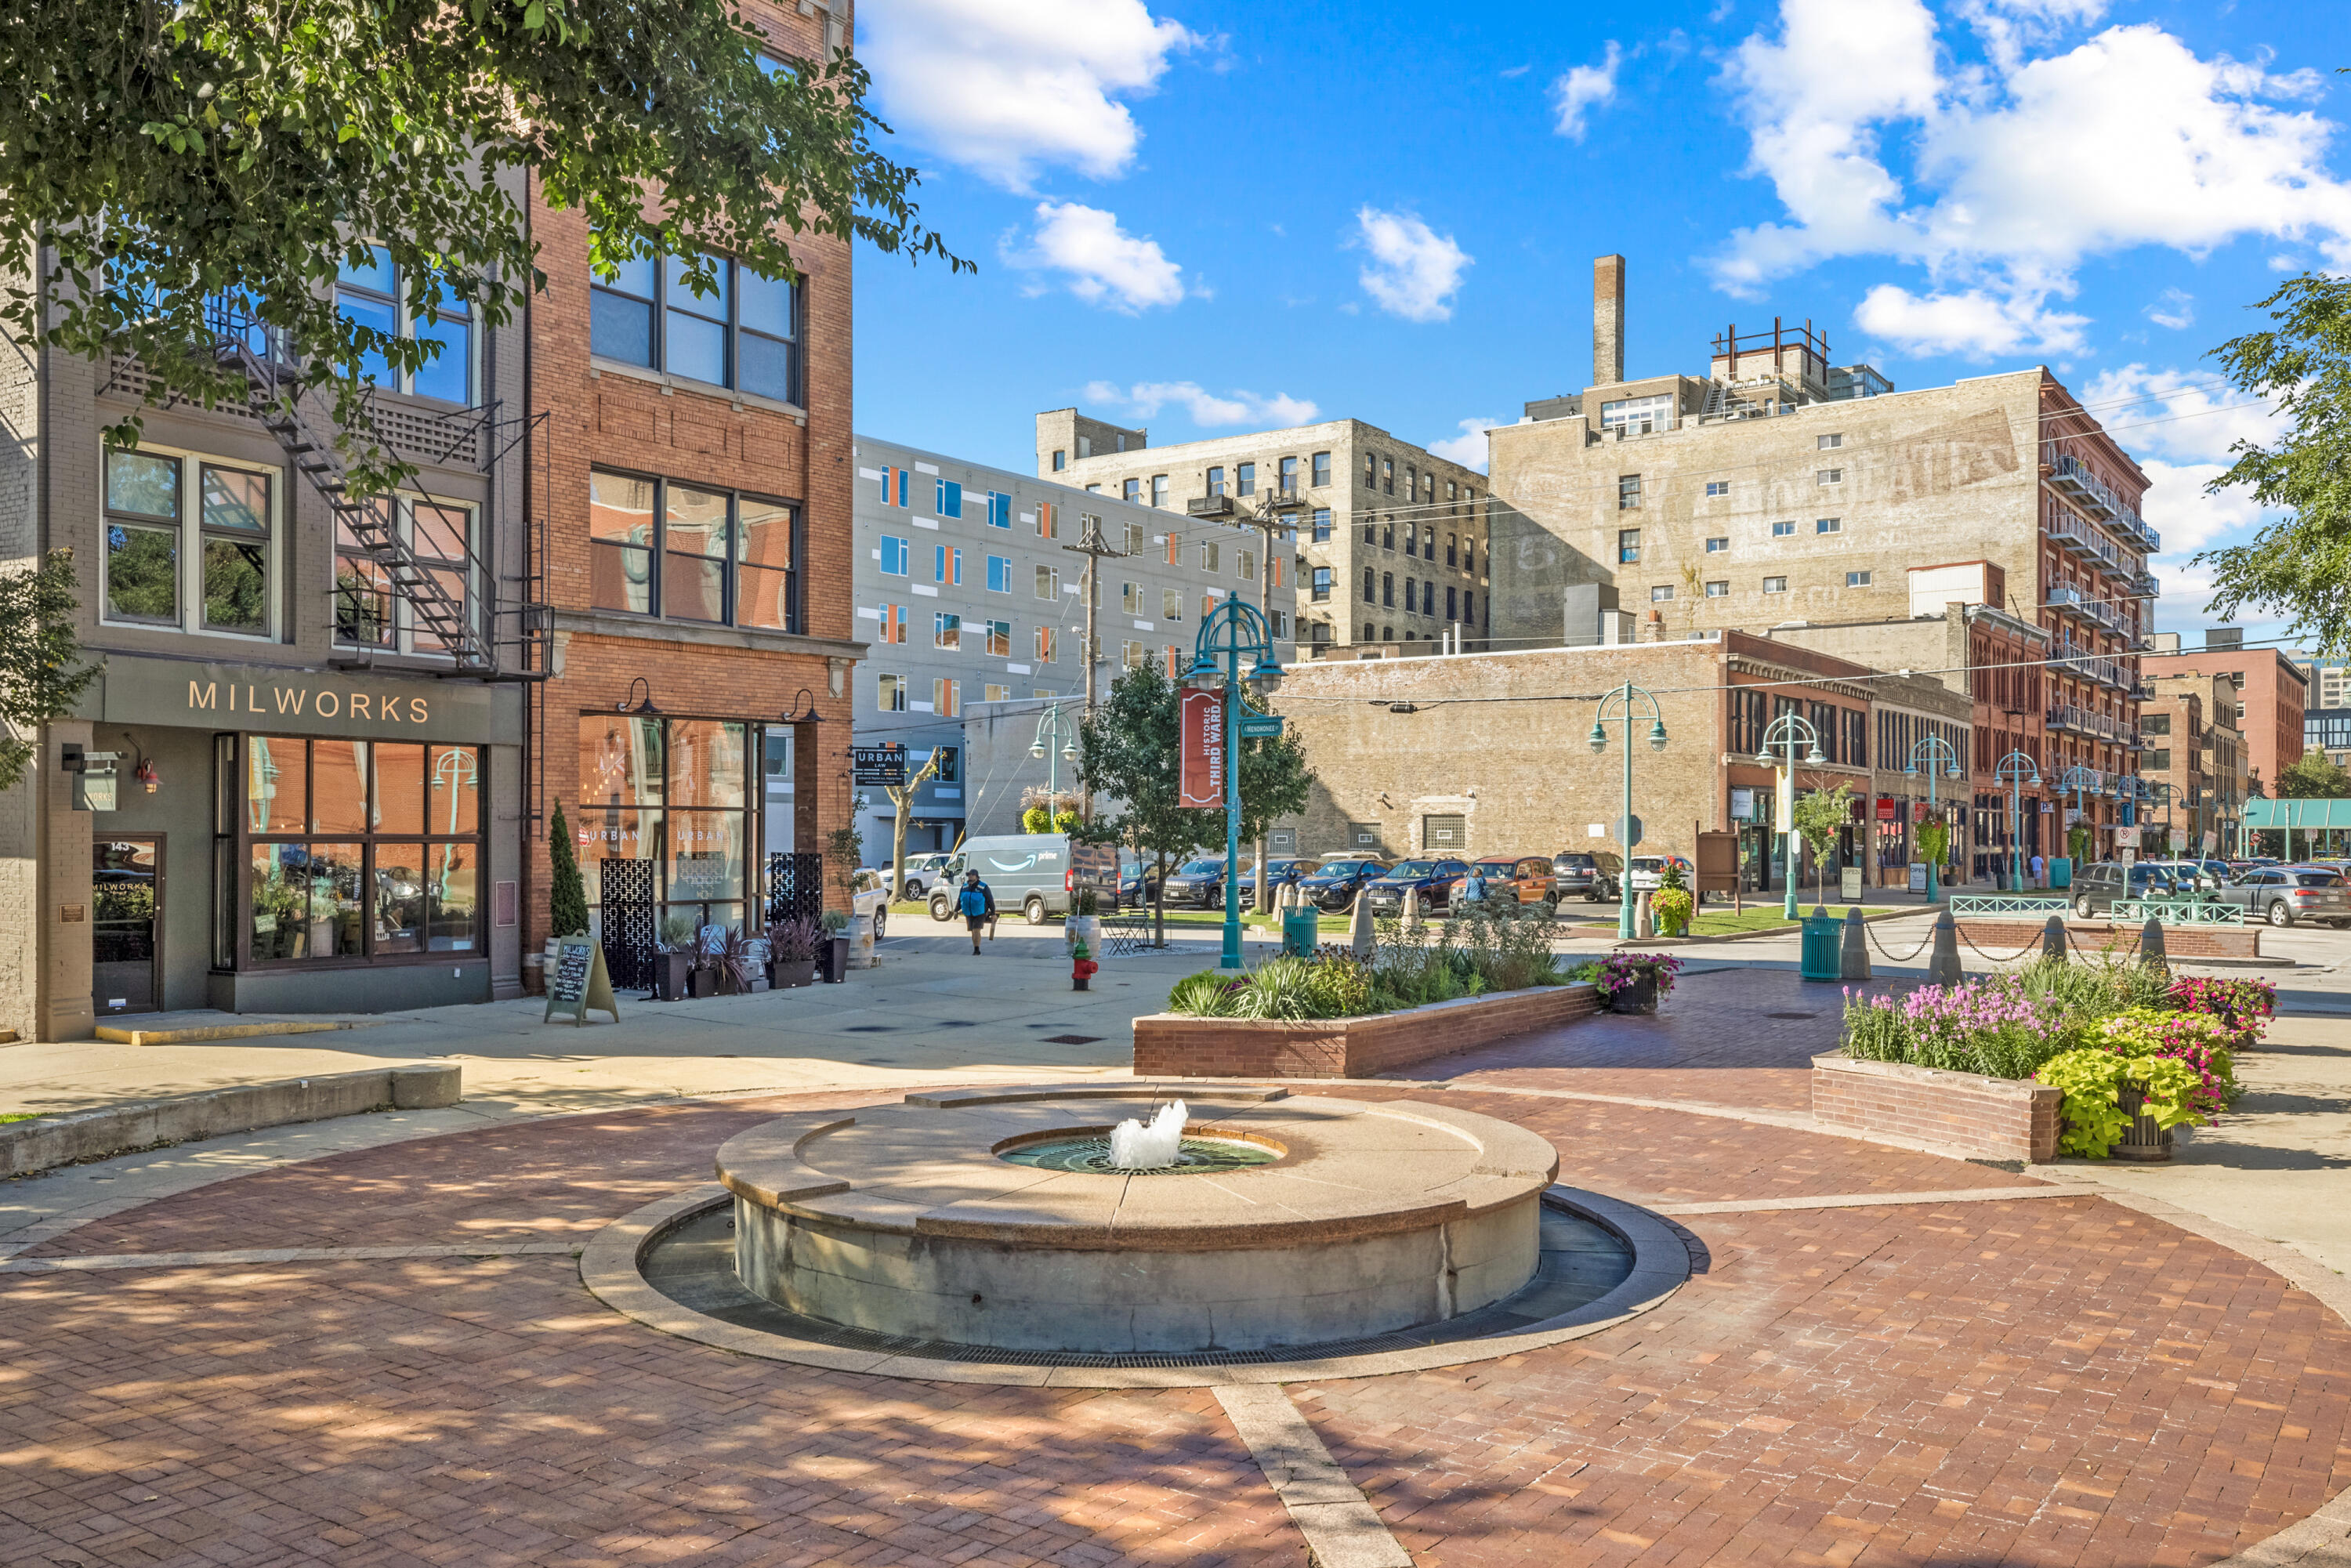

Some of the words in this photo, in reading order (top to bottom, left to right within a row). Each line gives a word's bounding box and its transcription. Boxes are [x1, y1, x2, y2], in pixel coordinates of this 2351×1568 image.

[189, 680, 429, 723] MILWORKS
[1211, 705, 1222, 744] WARD
[858, 753, 902, 762] URBAN
[1210, 747, 1221, 788] THIRD
[589, 831, 639, 841] URBAN
[678, 831, 723, 841] URBAN
[110, 842, 130, 851] 143
[1038, 851, 1057, 862] prime
[92, 882, 148, 891] MILWORKS
